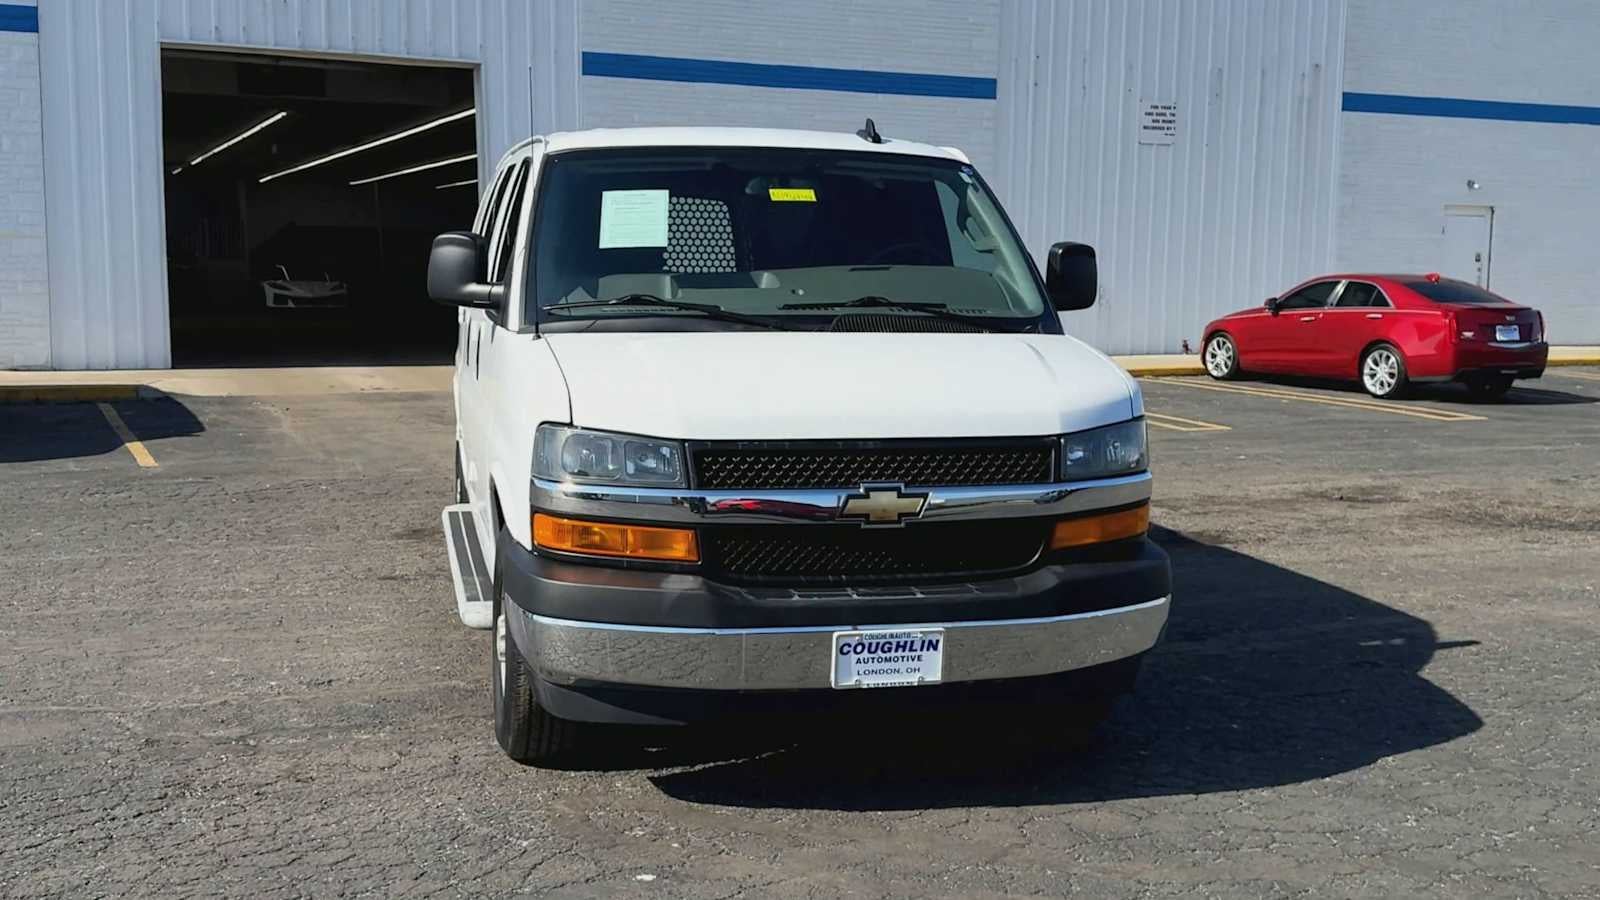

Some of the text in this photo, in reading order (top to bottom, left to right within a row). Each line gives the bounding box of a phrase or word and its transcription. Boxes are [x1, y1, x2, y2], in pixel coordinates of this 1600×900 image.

[839, 639, 940, 656] COUGHLIN
[855, 654, 923, 665] AUTOMOTIVE
[905, 666, 921, 674] OH
